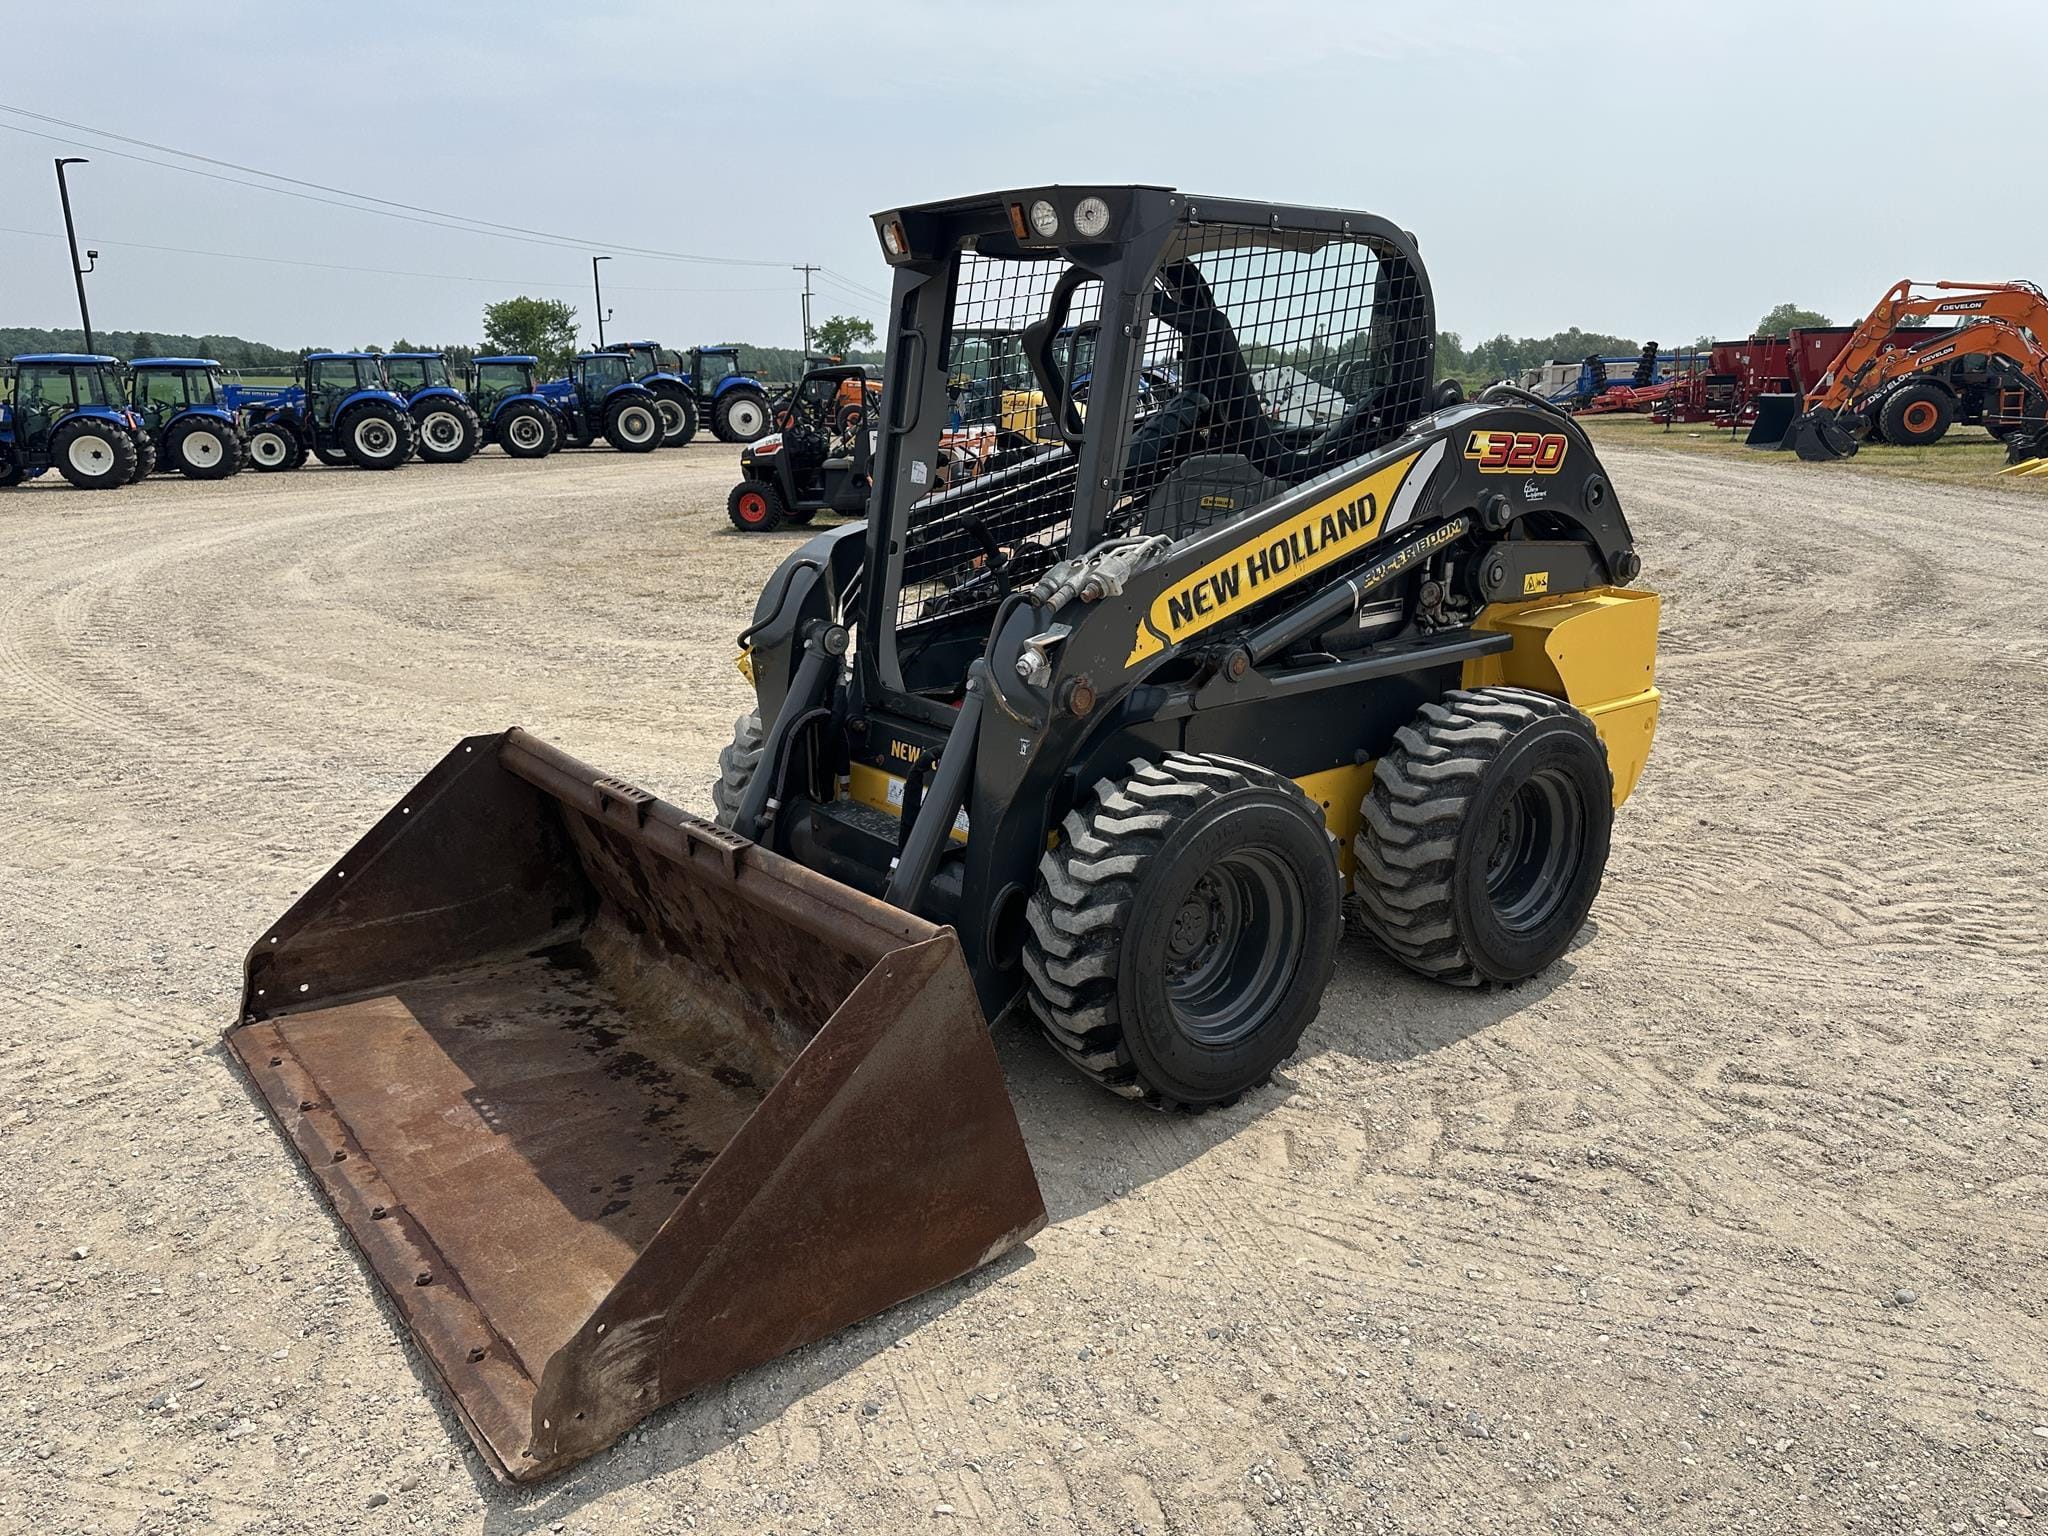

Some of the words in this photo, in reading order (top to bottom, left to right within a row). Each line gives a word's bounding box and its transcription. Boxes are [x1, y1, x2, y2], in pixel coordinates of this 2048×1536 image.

[1942, 302, 1982, 311] DEVELON
[1921, 346, 1954, 363] DEVELON
[1464, 431, 1568, 474] L320
[1416, 518, 1463, 552] BOOM
[1167, 562, 1240, 631] NEW
[1246, 491, 1377, 588] HOLLAND
[891, 739, 921, 763] NEW
